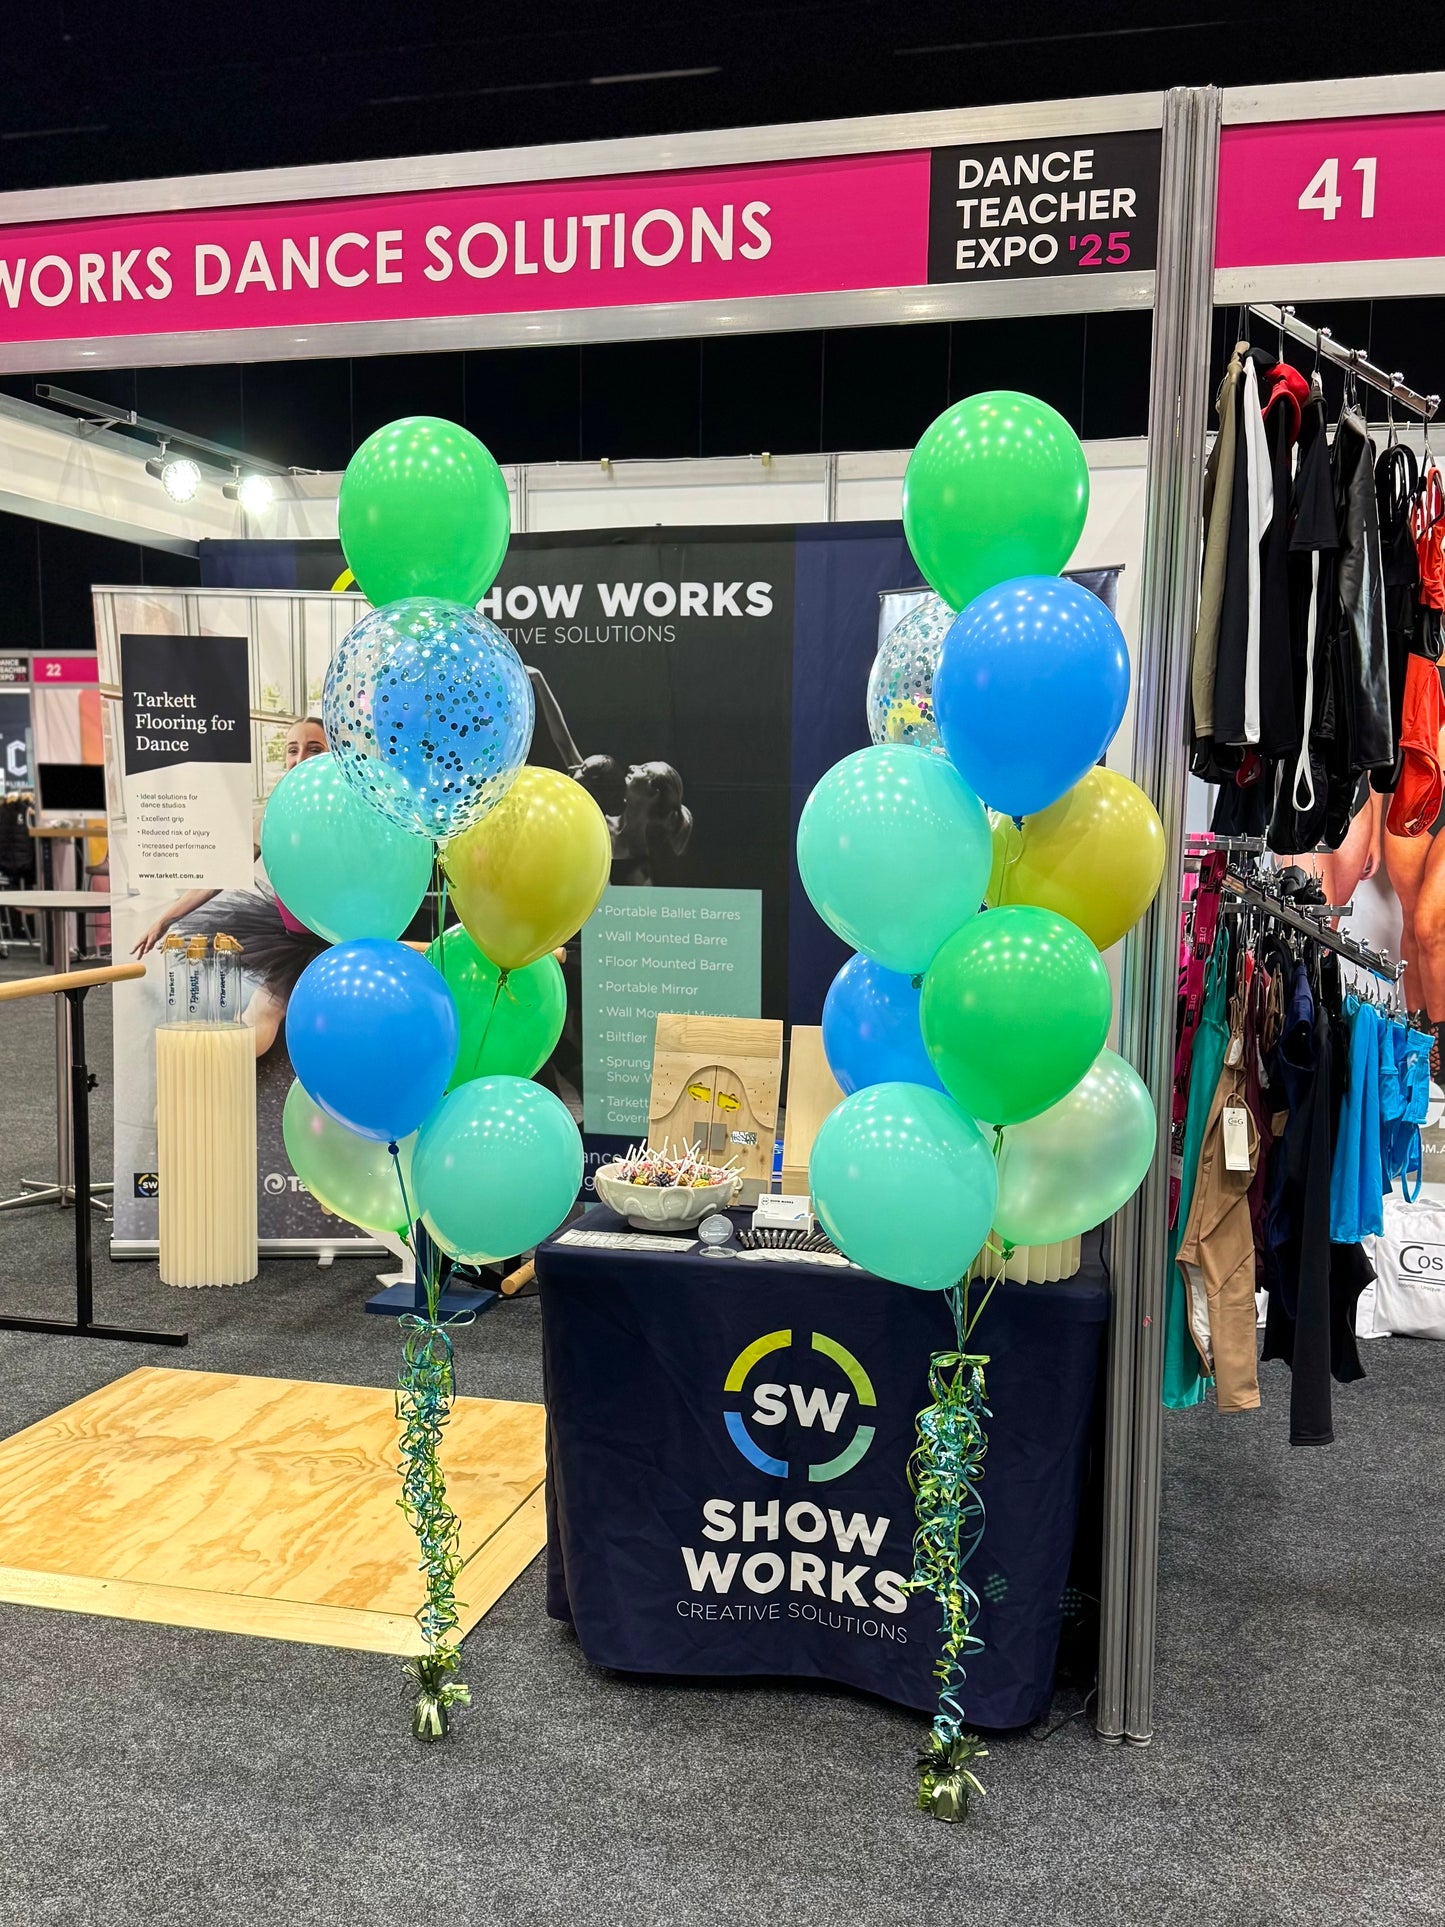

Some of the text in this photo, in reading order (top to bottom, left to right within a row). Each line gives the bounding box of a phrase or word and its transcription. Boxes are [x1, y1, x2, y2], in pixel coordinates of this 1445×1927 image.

[957, 149, 1094, 190] DANCE
[1298, 157, 1377, 221] 41
[956, 187, 1136, 229] TEACHER
[0, 201, 772, 308] WORKS DANCE SOLUTIONS
[956, 231, 1131, 270] EXPO '25
[475, 582, 774, 620] HOW WORKS
[502, 625, 676, 645] TIVE SOLUTIONS
[0, 666, 27, 674] EACHER
[46, 664, 62, 677] 22
[133, 691, 197, 708] Tarkett
[135, 713, 236, 734] Flooring for
[136, 735, 190, 752] Dance
[175, 843, 217, 851] performance
[605, 906, 741, 920] Portable Ballet Barres
[605, 931, 728, 945] Wall Mounted Barre
[605, 956, 734, 971] Floor Mounted Barre
[605, 981, 699, 995] Portable Mirror
[606, 1006, 632, 1017] Wall
[607, 1056, 651, 1070] Sprung
[607, 1071, 641, 1082] Show
[607, 1096, 648, 1108] Tarkett
[607, 1112, 650, 1123] Coveri
[751, 1383, 850, 1433] SW
[701, 1498, 891, 1557] SHOW
[680, 1546, 909, 1615] WORKS
[676, 1600, 908, 1645] CREATIVE SOLUTIONS
